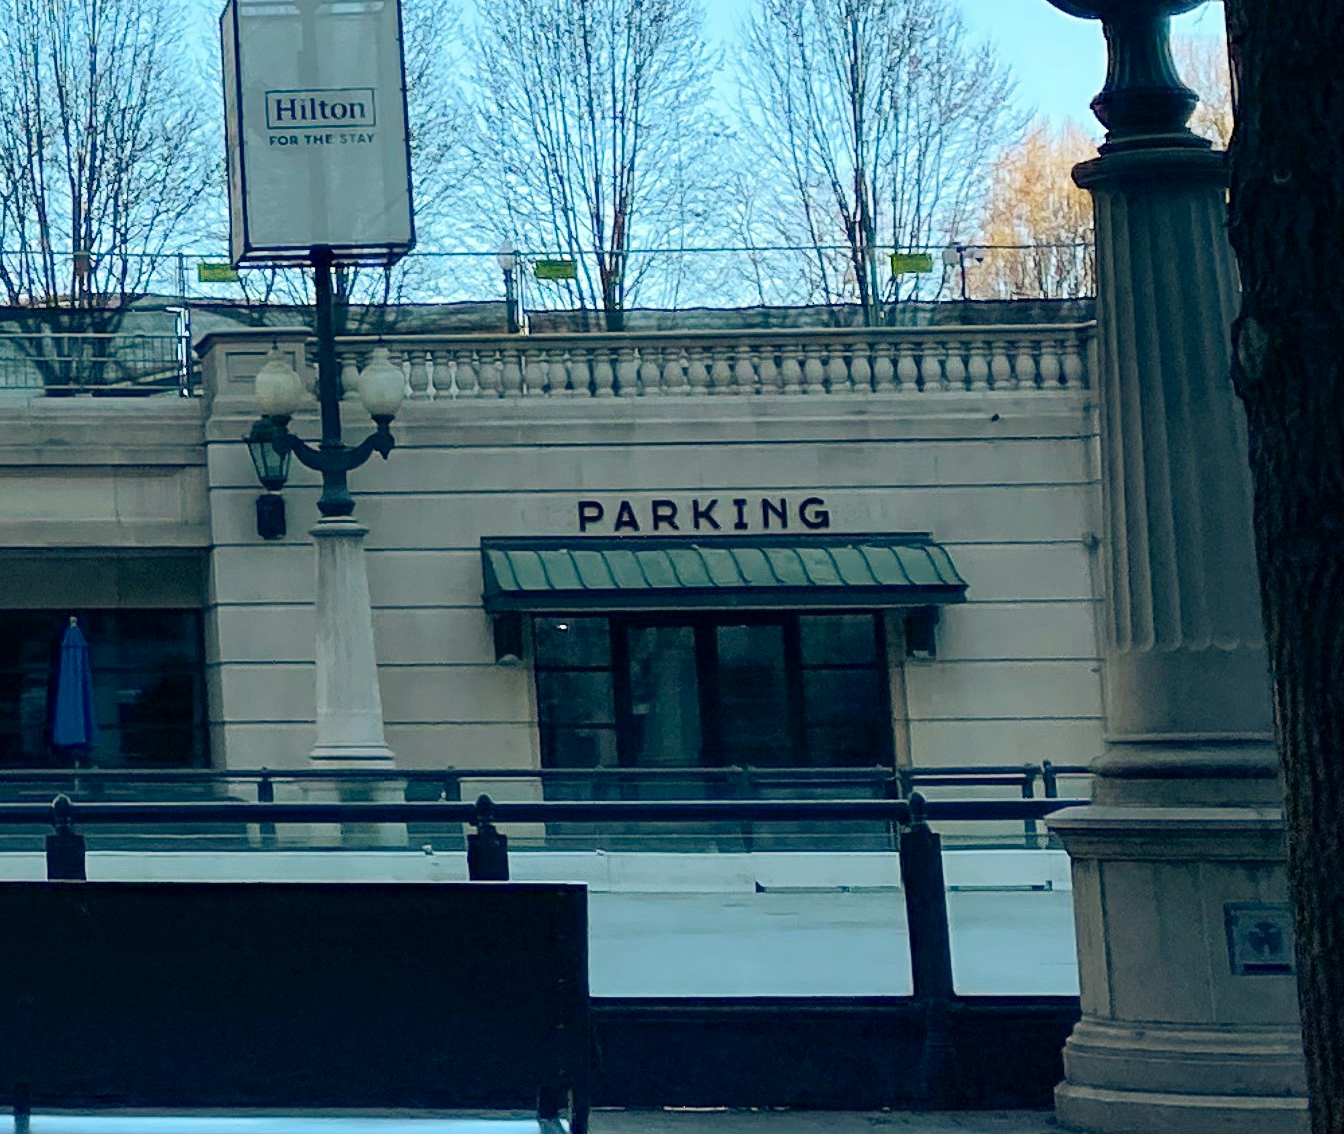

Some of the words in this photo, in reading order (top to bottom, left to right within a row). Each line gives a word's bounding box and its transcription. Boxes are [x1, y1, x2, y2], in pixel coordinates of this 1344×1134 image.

[276, 97, 366, 121] Hilton
[269, 135, 299, 146] FOR
[304, 134, 333, 145] THE
[339, 133, 374, 144] STAY
[578, 497, 830, 532] PARKING
